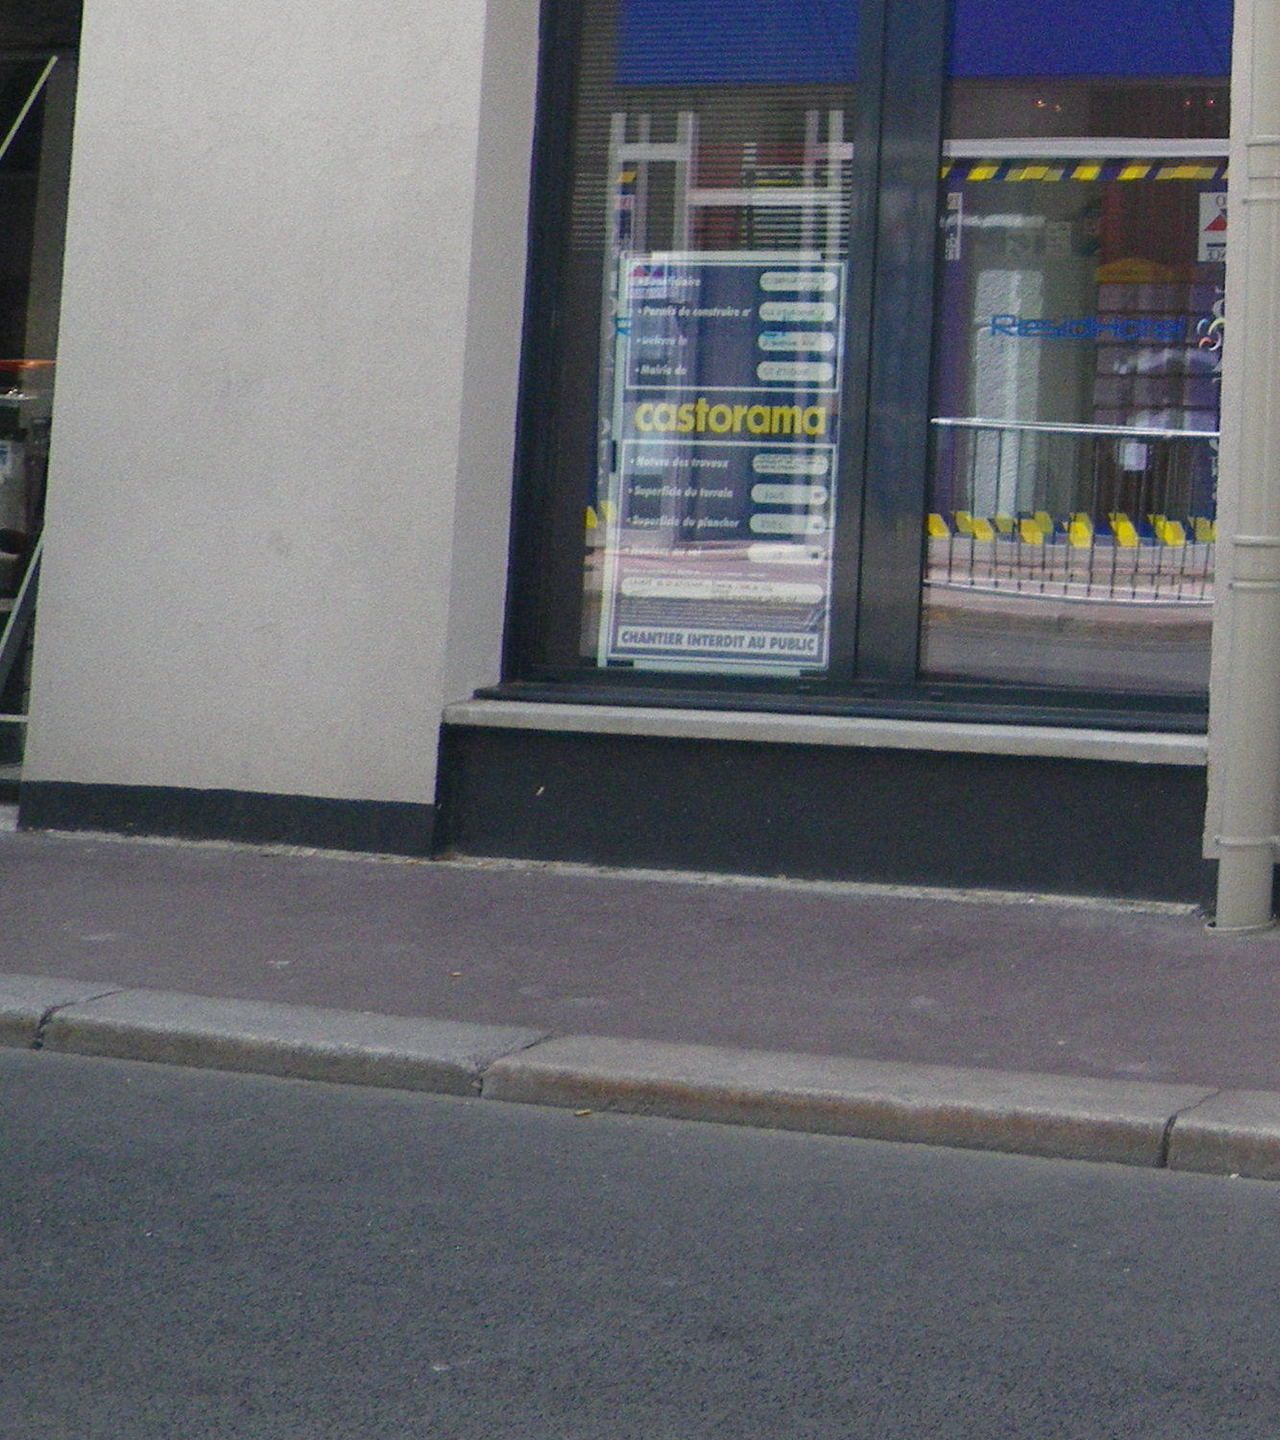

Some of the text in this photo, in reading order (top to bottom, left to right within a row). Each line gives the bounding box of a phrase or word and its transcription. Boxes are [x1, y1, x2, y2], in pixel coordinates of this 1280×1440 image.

[634, 397, 827, 436] castorama
[621, 630, 816, 652] CHANTIER INTERDIT AU PUBLIC
